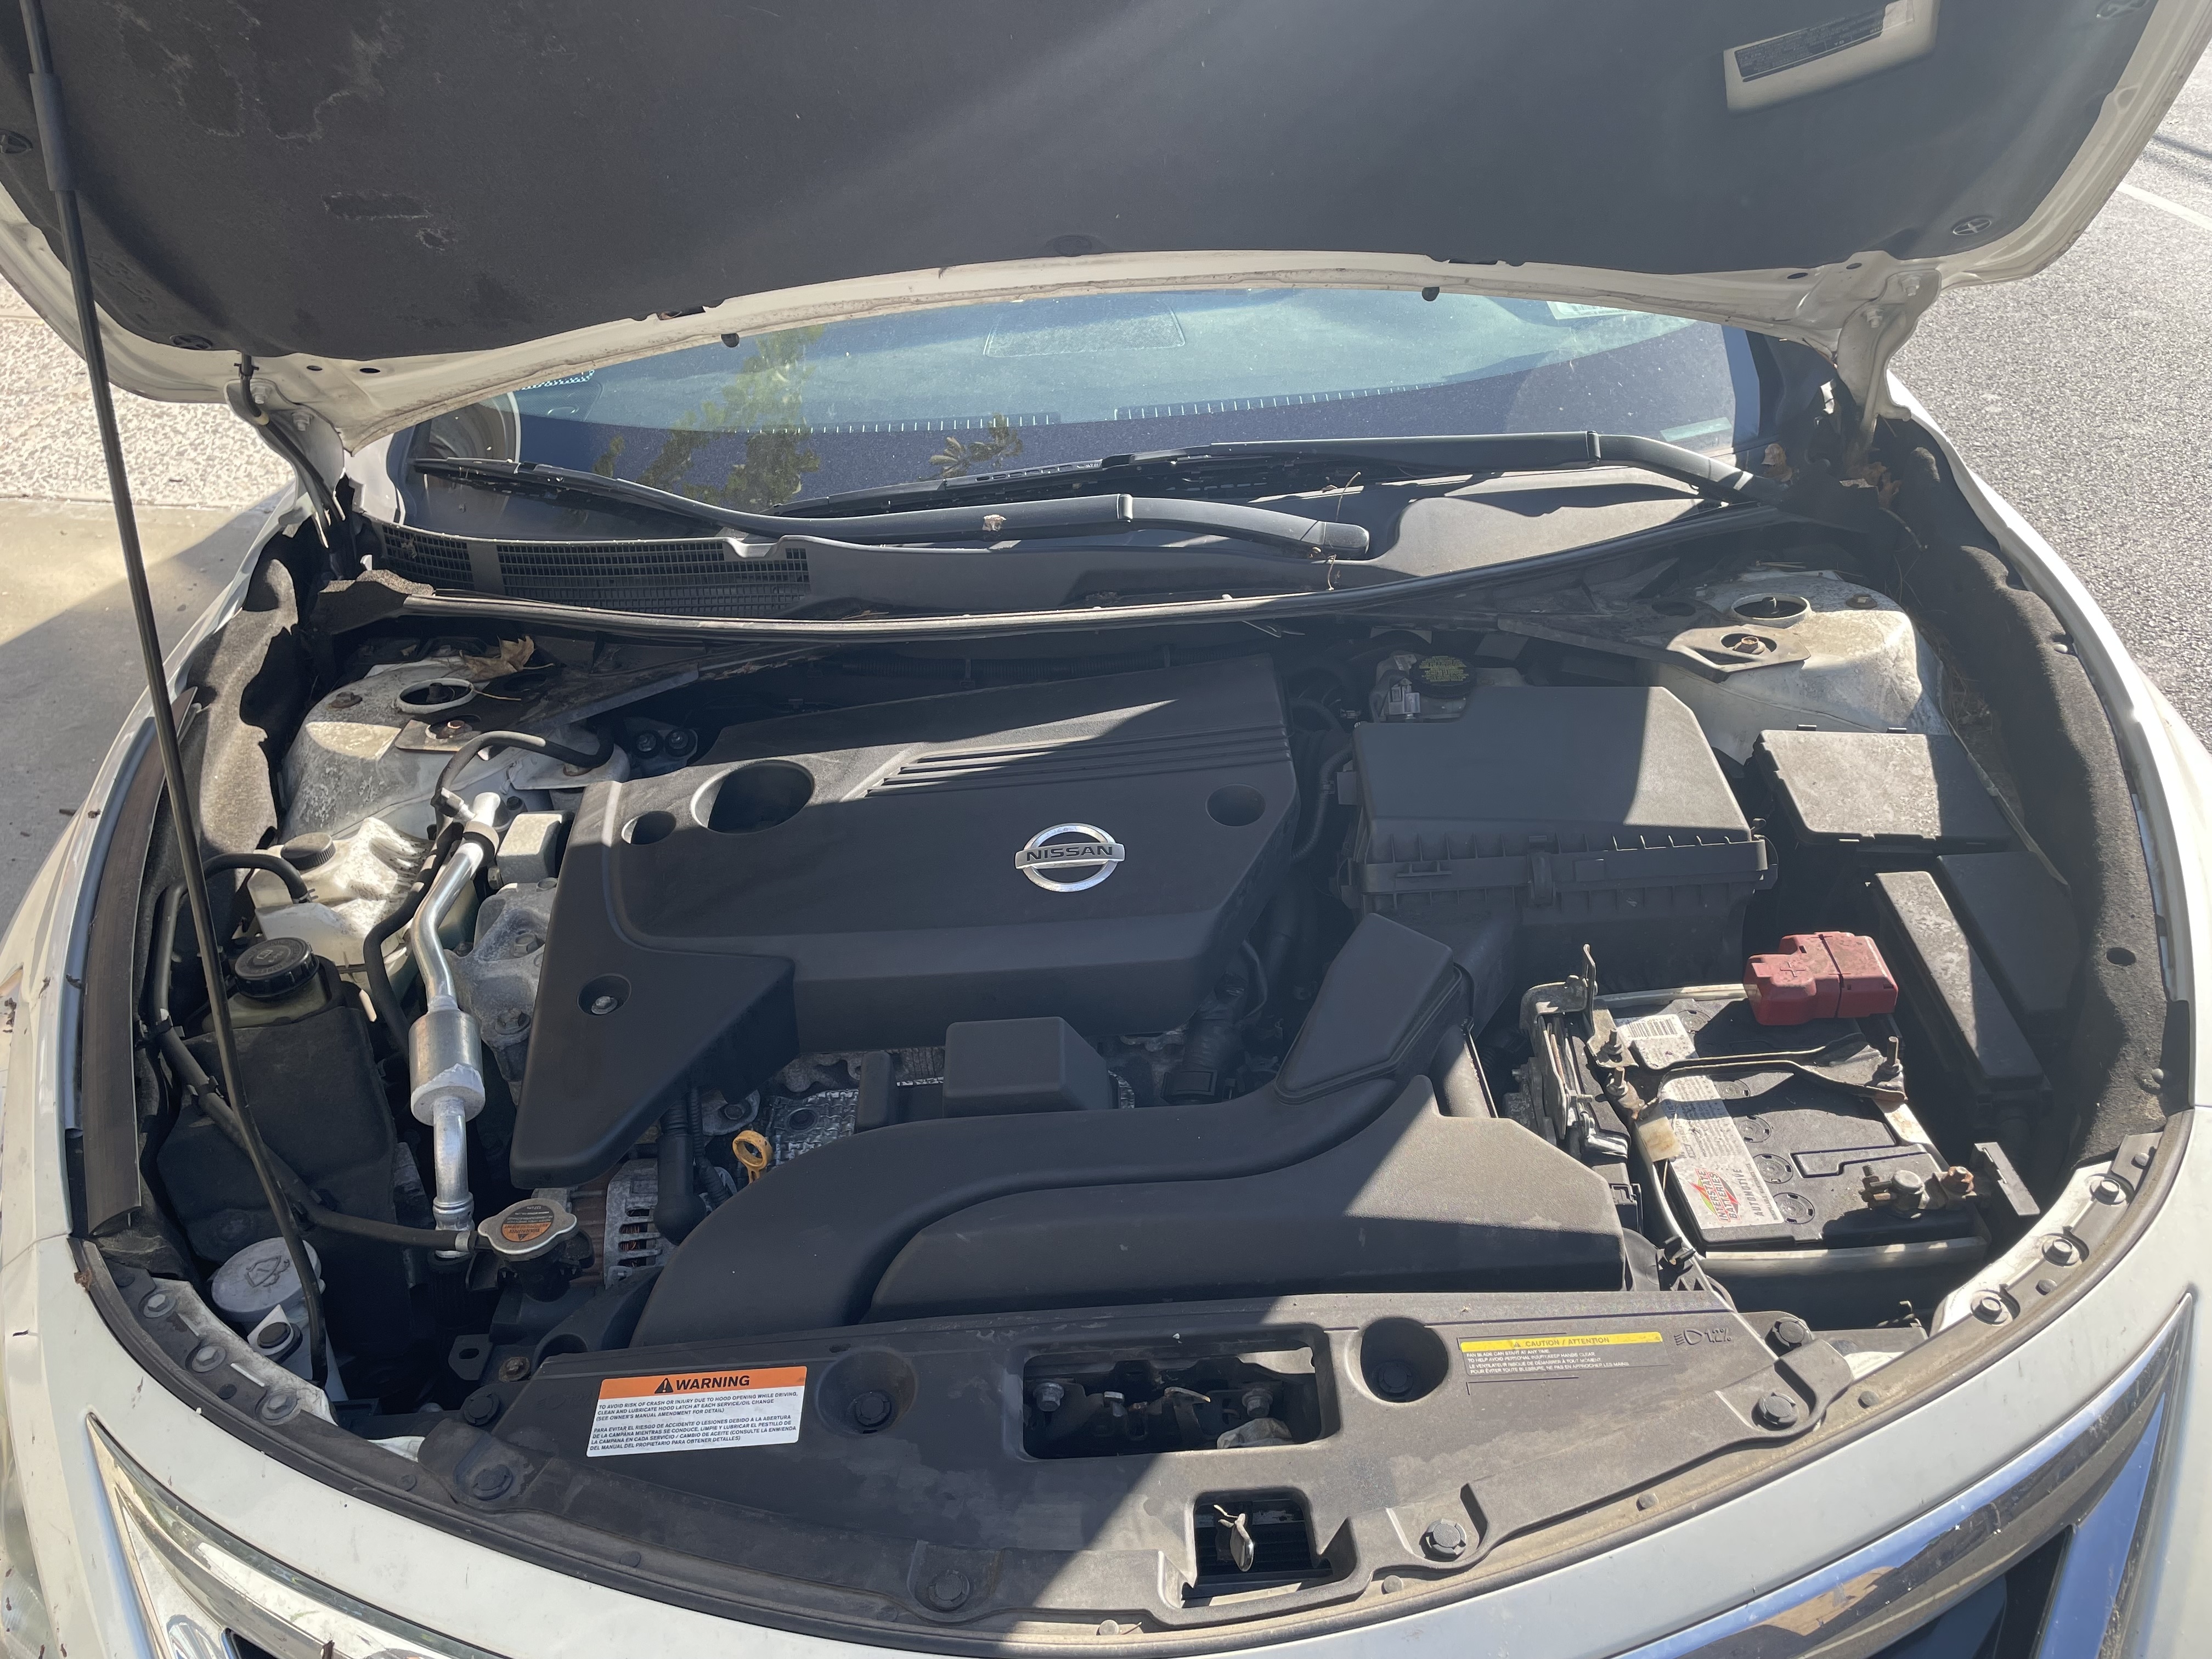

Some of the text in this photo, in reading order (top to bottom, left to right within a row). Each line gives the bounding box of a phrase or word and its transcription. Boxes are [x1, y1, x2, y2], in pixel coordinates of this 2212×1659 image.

[1027, 845, 1112, 861] NISSAN
[1697, 1170, 1728, 1221] INTERSTATE
[1709, 1173, 1738, 1219] BATTERIES
[1733, 1169, 1764, 1217] AUTOMOTIVE
[676, 1375, 750, 1390] WARNING
